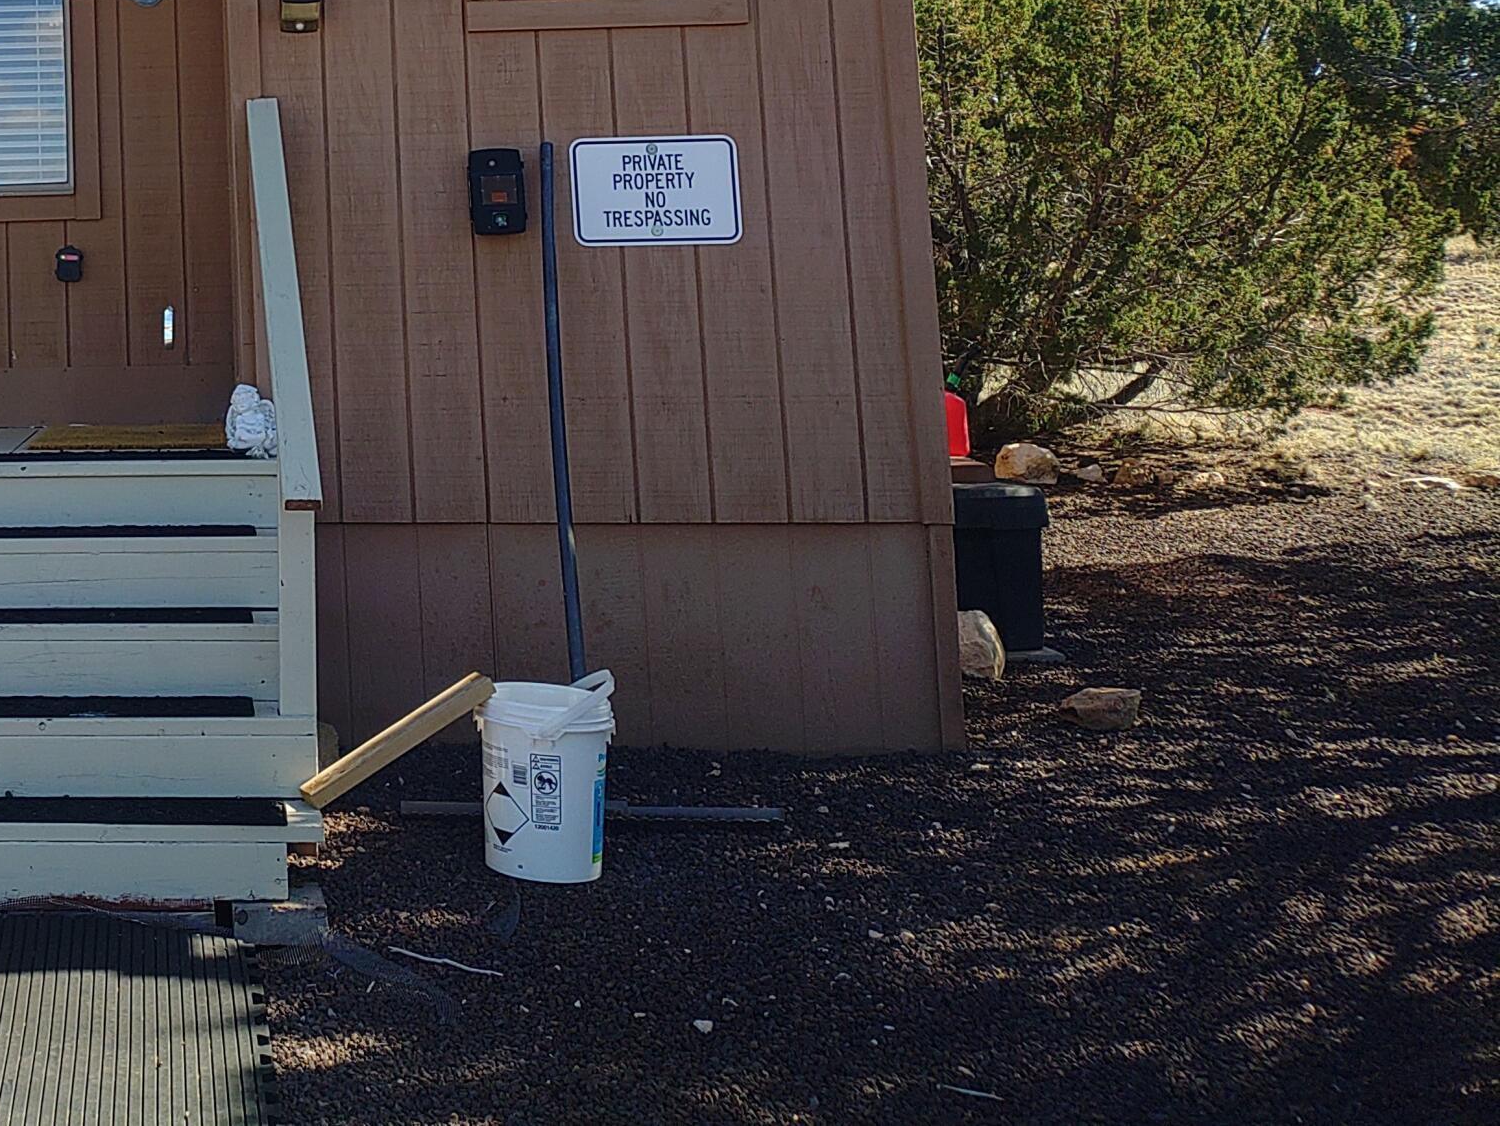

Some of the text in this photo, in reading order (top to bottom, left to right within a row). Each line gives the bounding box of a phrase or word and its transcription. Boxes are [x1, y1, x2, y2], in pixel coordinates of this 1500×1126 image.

[622, 154, 684, 172] PRIVATE
[613, 172, 695, 190] PROPERTY
[645, 191, 666, 208] NO
[603, 209, 712, 227] TRESPASSING
